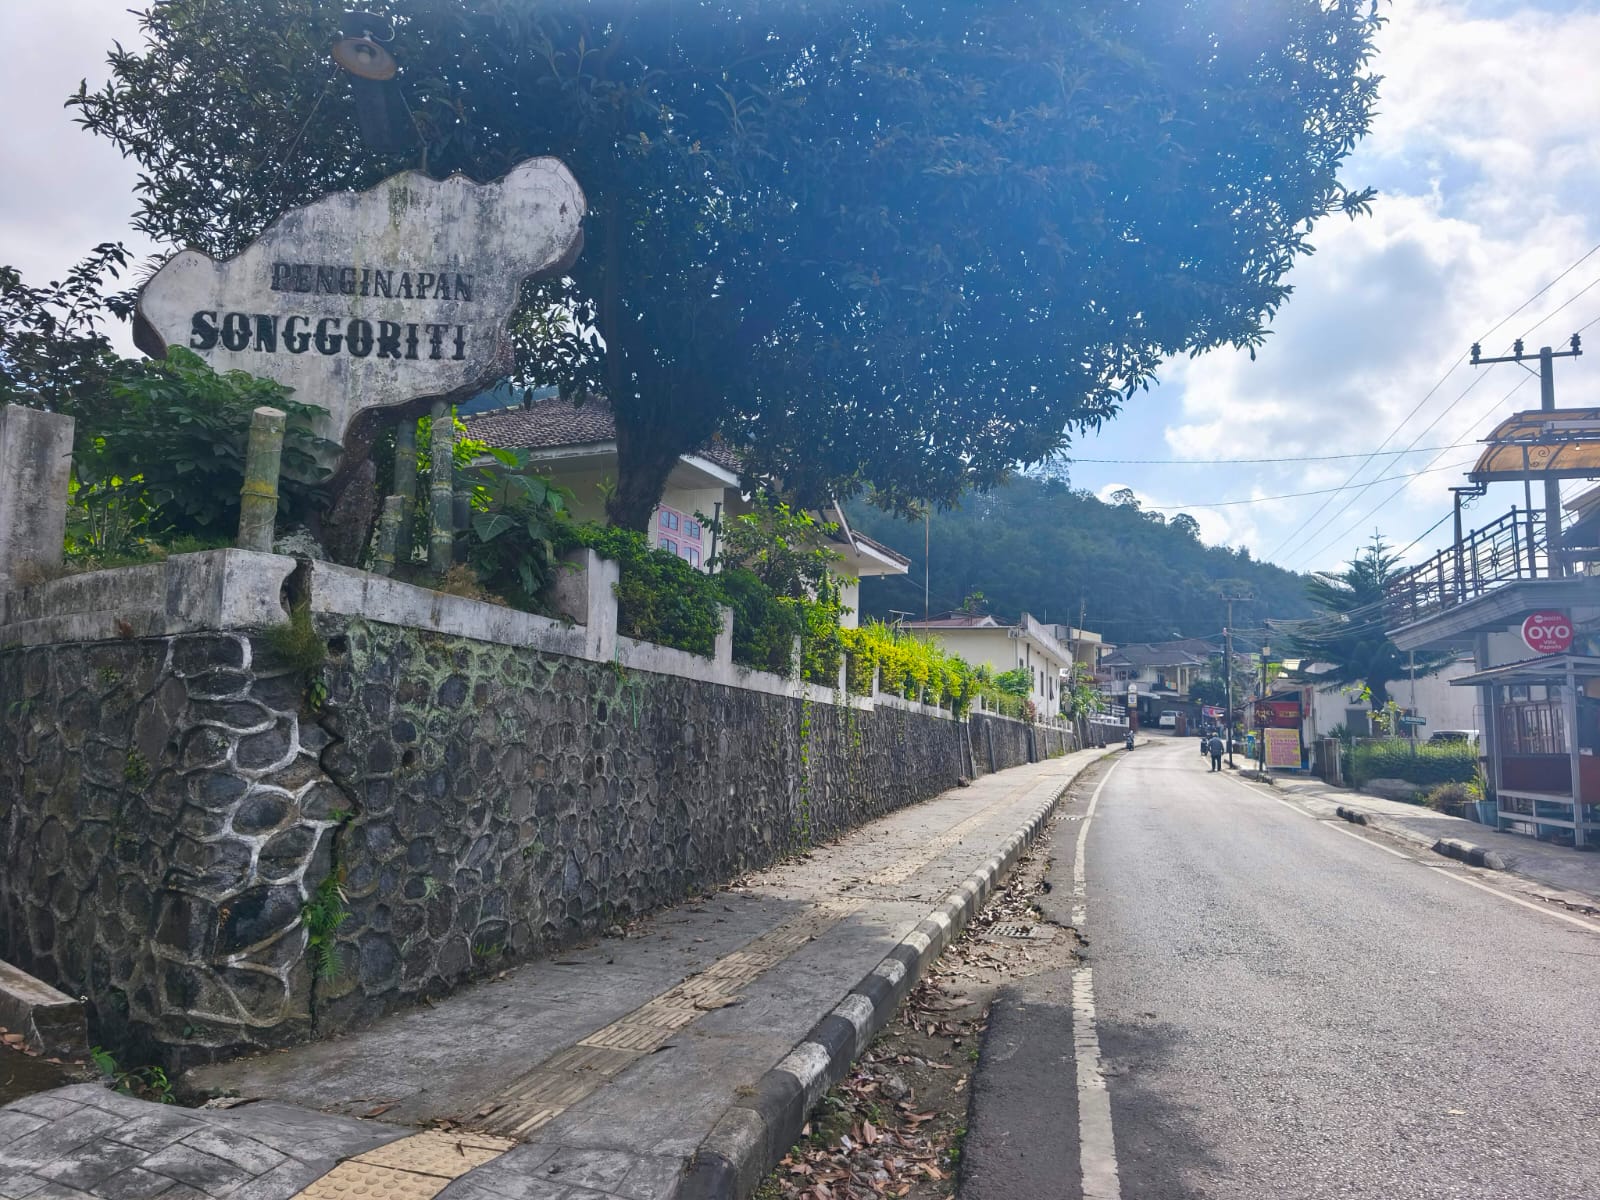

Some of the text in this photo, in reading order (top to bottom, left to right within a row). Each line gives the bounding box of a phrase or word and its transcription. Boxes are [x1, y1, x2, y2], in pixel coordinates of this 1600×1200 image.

[271, 262, 474, 301] PENGINAPAN
[190, 310, 466, 361] SONGGORITI
[1528, 625, 1570, 640] OYO
